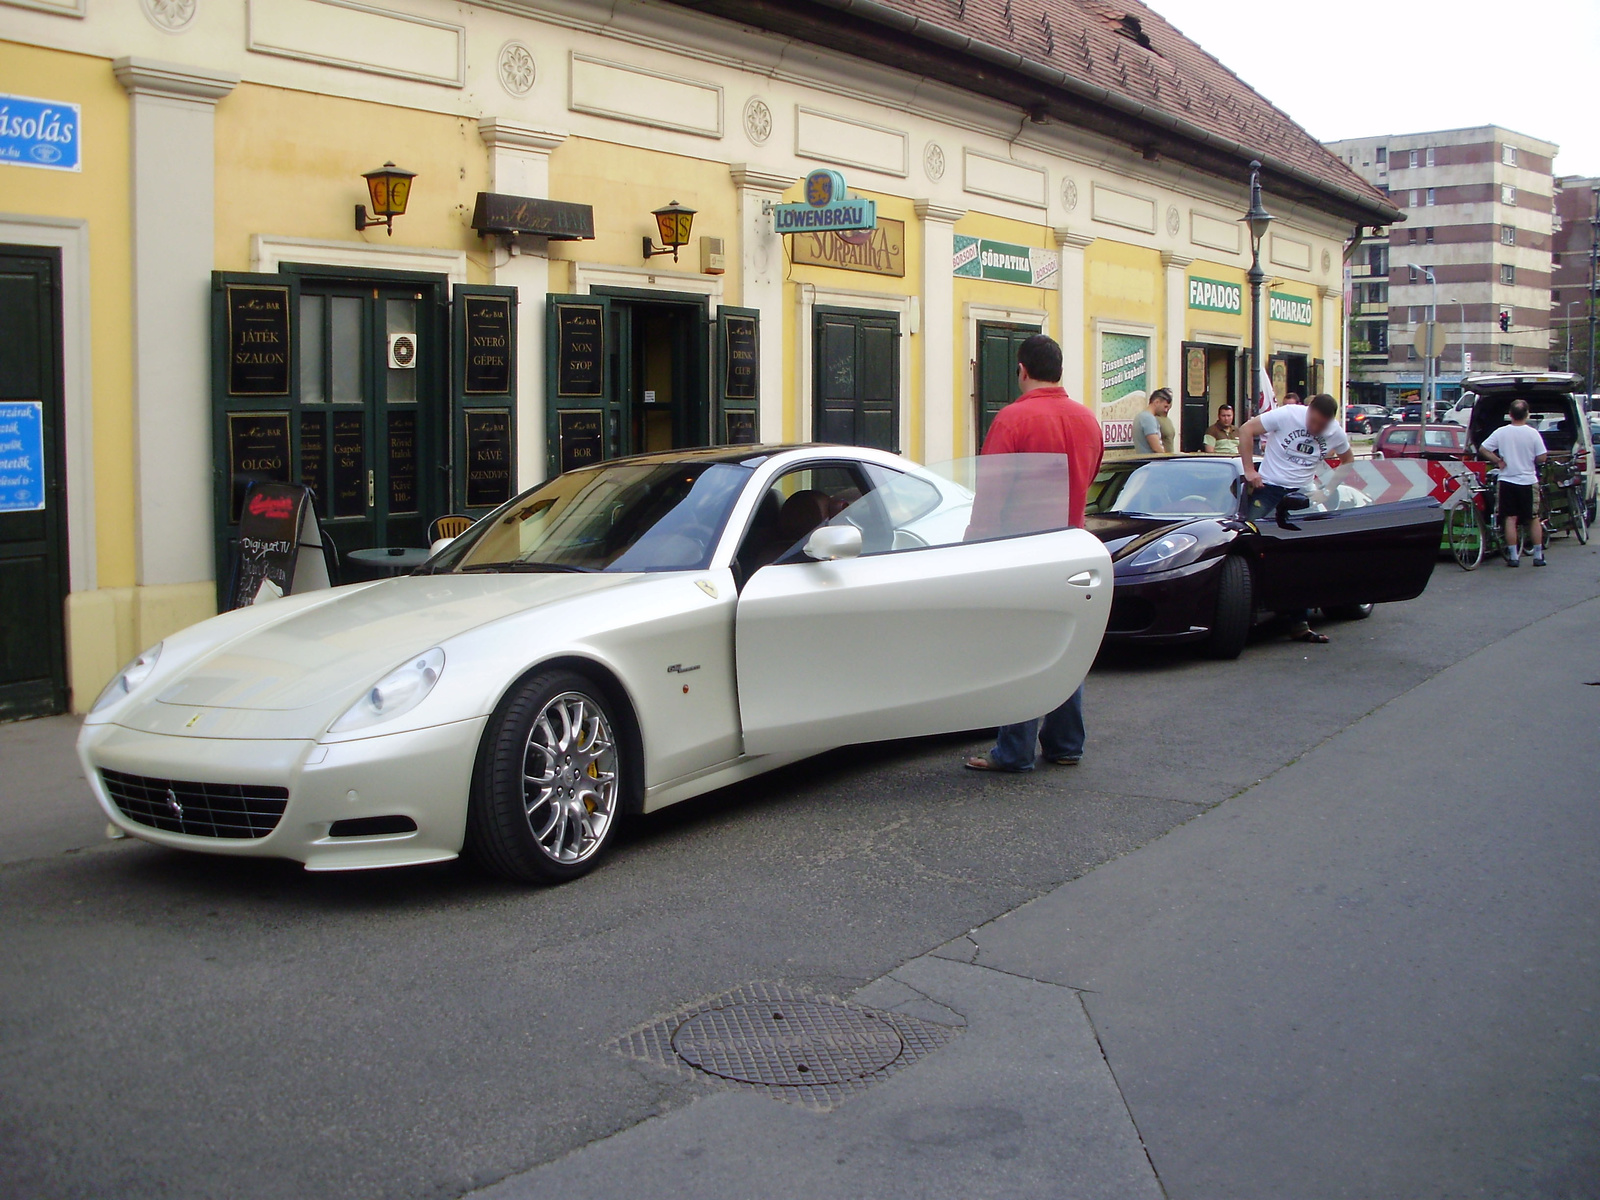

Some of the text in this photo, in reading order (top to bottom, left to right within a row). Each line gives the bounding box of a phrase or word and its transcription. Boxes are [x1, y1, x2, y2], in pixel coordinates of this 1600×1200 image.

[777, 207, 863, 228] LÖWENBRÄU
[953, 246, 976, 268] BORSODI
[982, 249, 1030, 272] SÖRPATIKA
[1036, 260, 1057, 279] BORSODI
[1190, 281, 1240, 310] FAPADOS
[1270, 298, 1312, 324] POHARAZÓ
[240, 329, 279, 346] JÁTÉK
[473, 335, 506, 347] NYERŐ
[572, 343, 593, 352] NON
[236, 352, 284, 364] SZALON
[473, 354, 504, 366] GÉPEK
[733, 350, 752, 359] DRINK
[570, 361, 593, 370] STOP
[735, 366, 751, 375] CLUB
[1102, 359, 1124, 373] Frissen
[1101, 371, 1124, 389] Borsodi
[334, 443, 362, 456] Csapolt
[478, 449, 503, 460] KÁVÉ
[574, 448, 592, 457] BOR
[242, 456, 282, 470] OLCSÓ
[470, 471, 509, 480] SZENDVICS
[280, 541, 291, 554] TV
